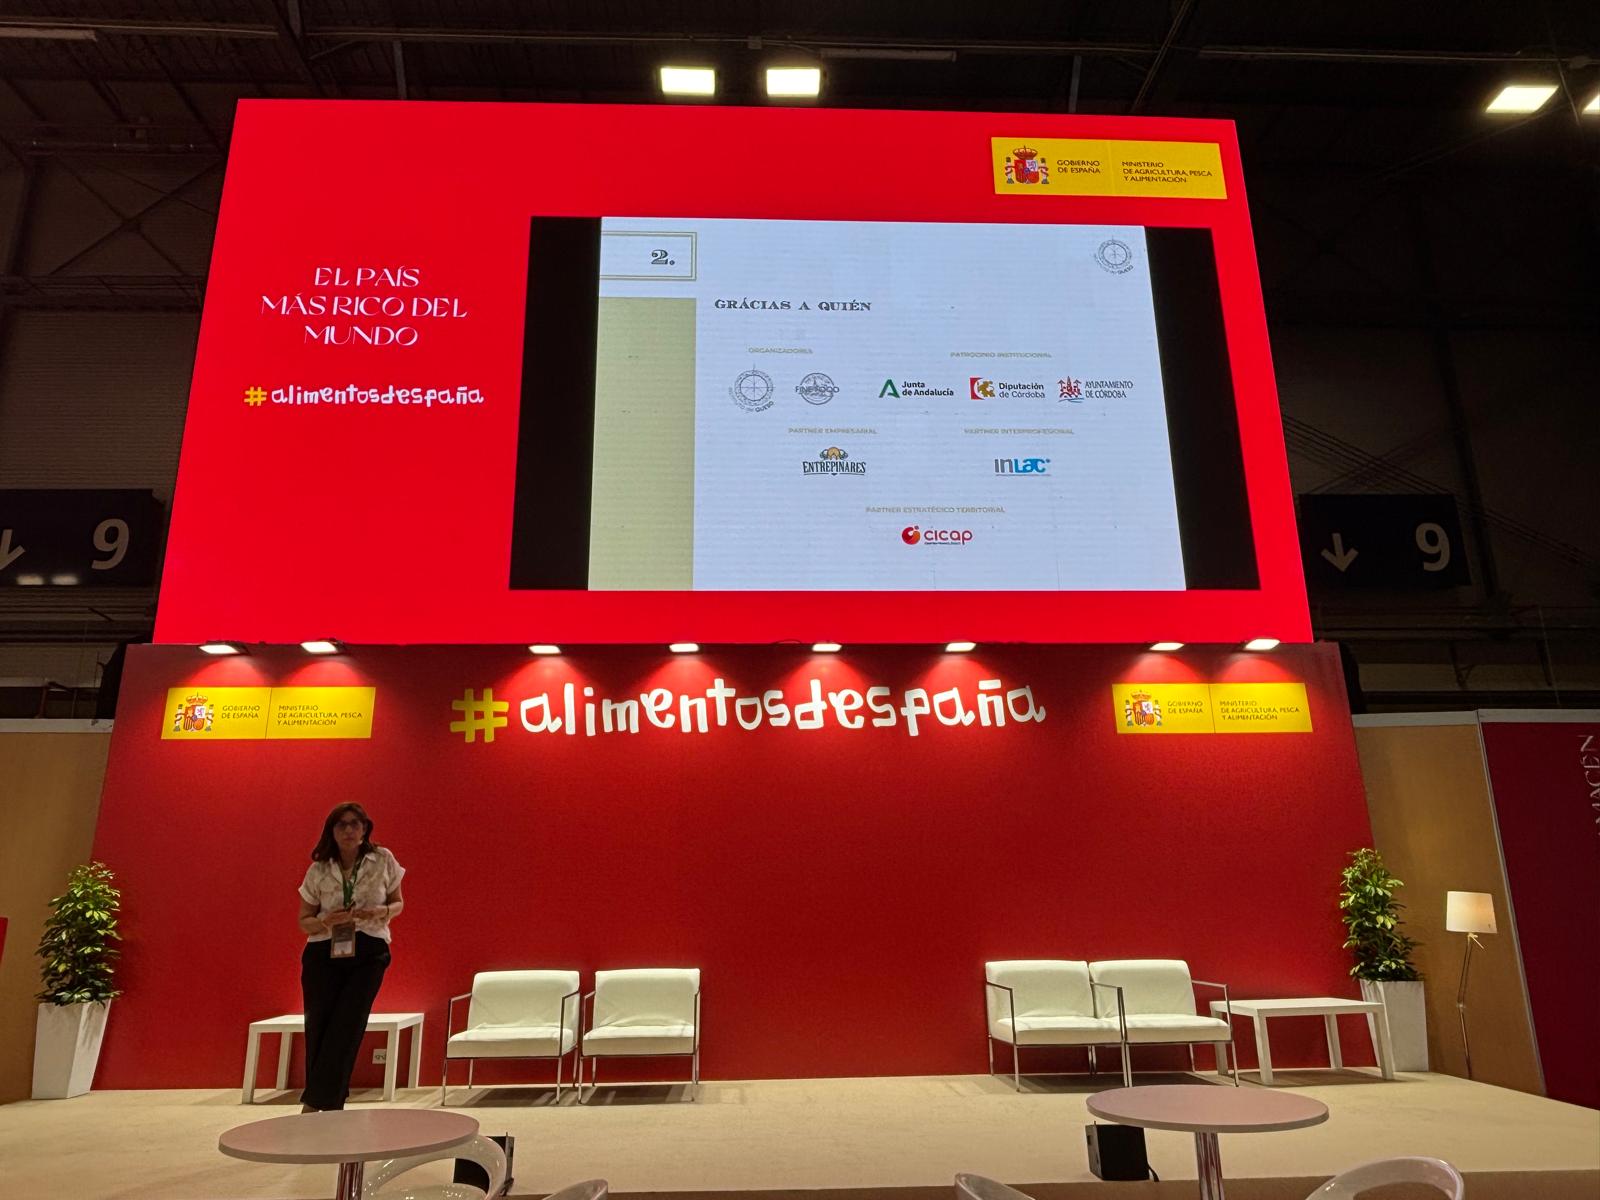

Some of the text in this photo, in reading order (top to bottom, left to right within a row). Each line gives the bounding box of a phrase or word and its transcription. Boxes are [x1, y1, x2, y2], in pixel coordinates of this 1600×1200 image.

[1057, 159, 1100, 167] GOBIERNO
[1071, 166, 1101, 174] ESPAÑA
[1130, 175, 1187, 183] ALIMENTACIÓN
[650, 249, 675, 266] 2.
[314, 265, 420, 287] EL PAÍS
[261, 292, 468, 318] MÁS RICO DEL
[715, 297, 872, 311] GRÁCIAS A QUIÉN
[304, 325, 418, 346] MUNDO
[902, 380, 926, 389] Junta
[999, 382, 1044, 392] Diputación
[1084, 380, 1133, 389] AYUNTAMIENTO
[243, 384, 484, 408] #alimentosdespaña
[914, 388, 954, 396] Andalucía
[1085, 389, 1127, 398] DE CÓRDOBA
[802, 461, 866, 474] ENTREPINARES
[924, 530, 973, 545] cicap
[91, 518, 130, 570] 9
[1415, 522, 1450, 571] 9
[232, 711, 259, 719] ESPAÑA
[449, 677, 1046, 744] #alimentosdespaña
[1179, 706, 1204, 714] ESPAÑA
[283, 718, 337, 726] ALIMENTACIÓN
[1227, 713, 1278, 721] ALIMENTACIÓN
